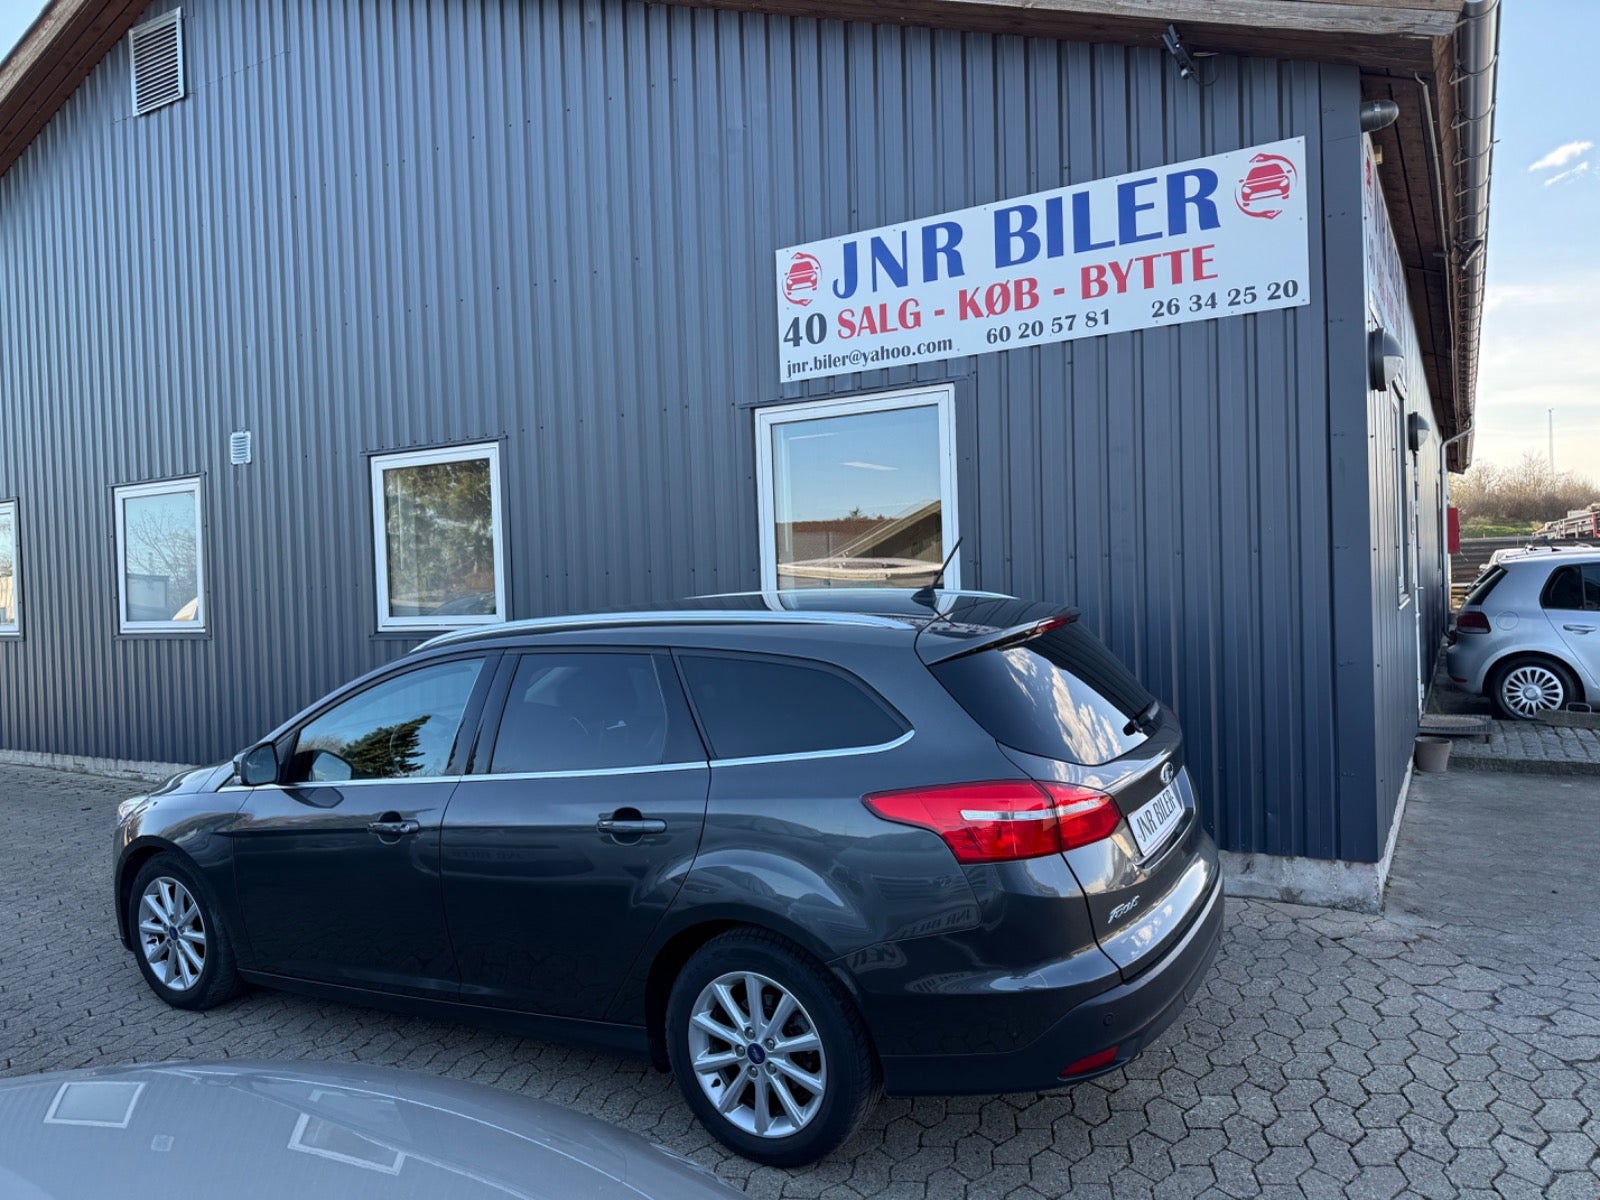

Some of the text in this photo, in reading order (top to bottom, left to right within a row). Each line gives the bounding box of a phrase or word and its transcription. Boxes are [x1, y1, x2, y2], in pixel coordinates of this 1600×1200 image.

[832, 168, 1221, 299] JNR BILER
[783, 244, 1218, 347] 40 SALG - KØB - BYTTE
[1151, 279, 1298, 318] 26 34 25 20
[986, 308, 1109, 344] 60 20 57 81
[787, 338, 953, 378] jnr.biler@yahoo.com
[1136, 789, 1177, 842] JNR BILER
